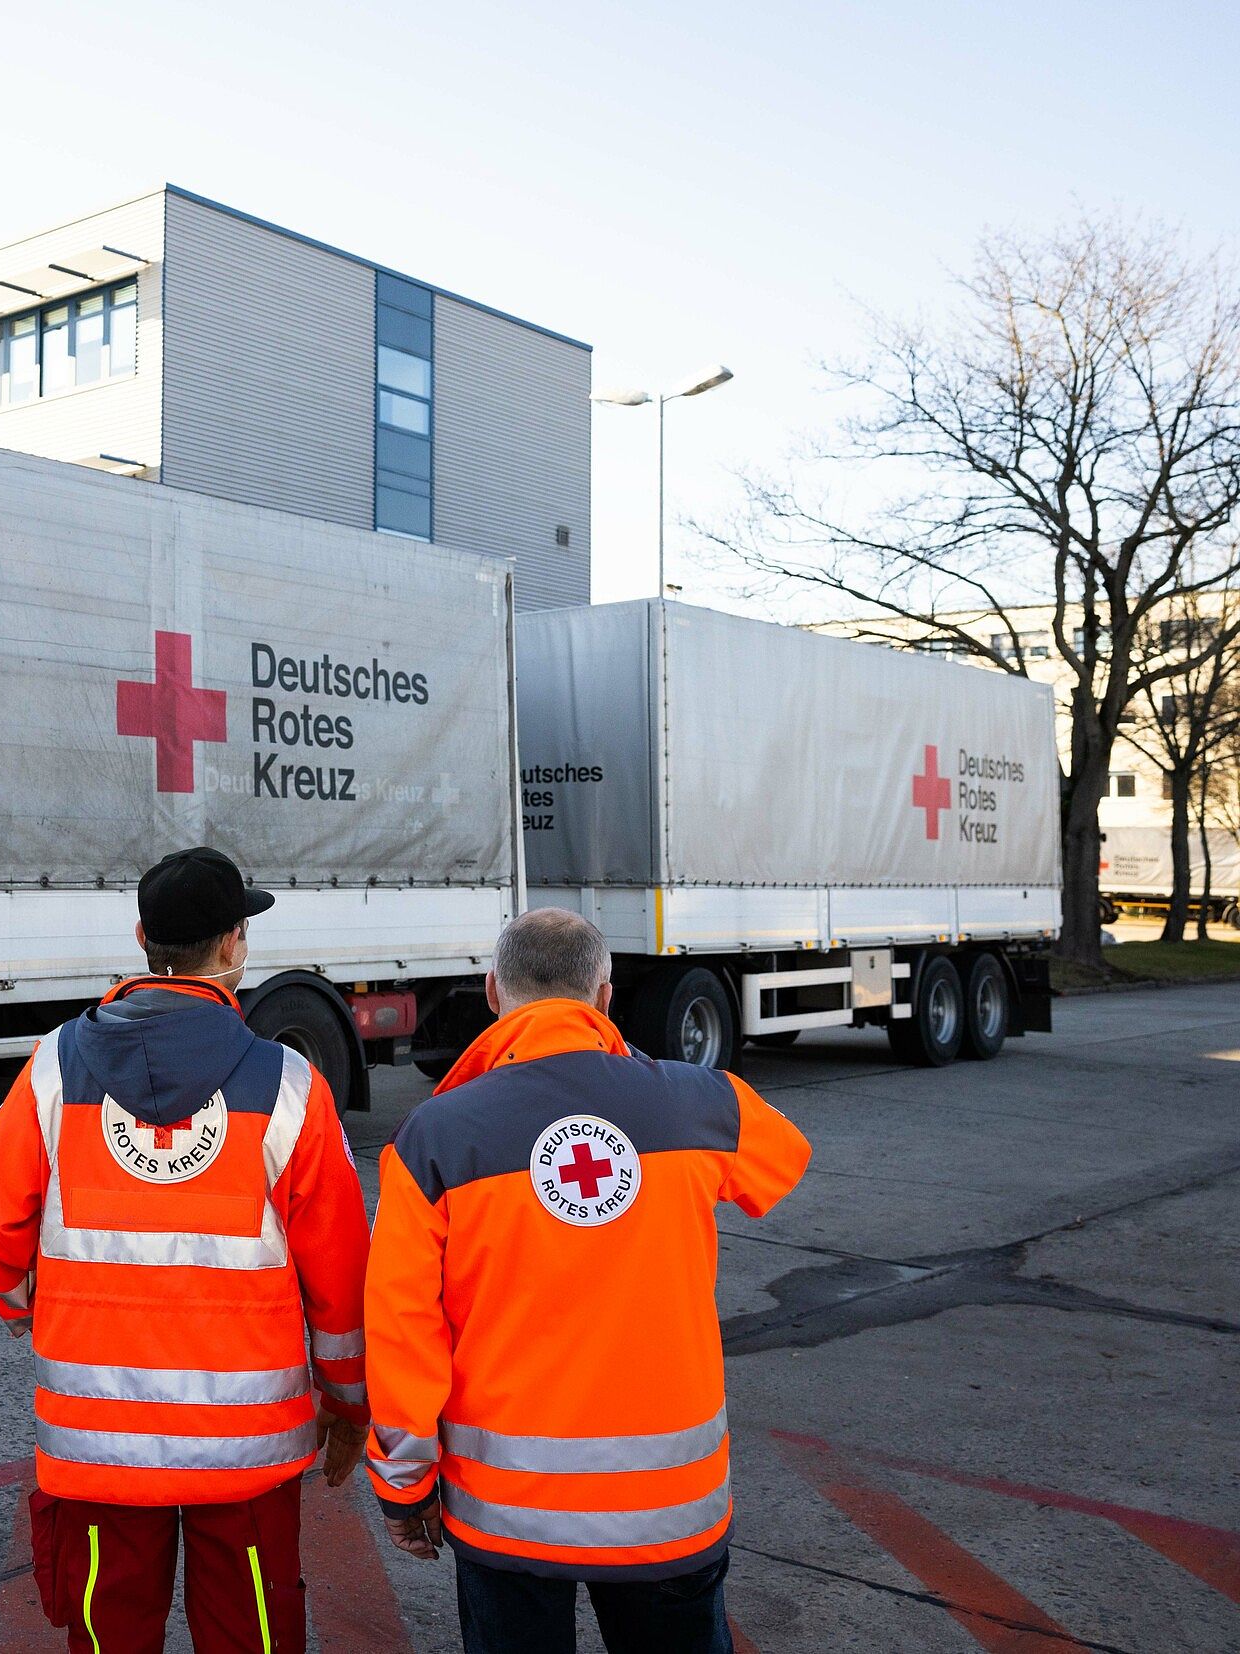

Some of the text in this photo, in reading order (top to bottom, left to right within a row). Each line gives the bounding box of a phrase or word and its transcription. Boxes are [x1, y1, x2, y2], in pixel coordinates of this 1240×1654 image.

[251, 642, 429, 705] Deutsches
[252, 697, 354, 749] Rotes
[254, 752, 356, 801] Kreuz
[520, 763, 603, 784] utsches
[959, 748, 1024, 782] Deutsches
[522, 788, 554, 807] tes
[959, 781, 996, 811] Rotes
[522, 815, 554, 831] euz
[959, 814, 998, 843] Kreuz
[112, 1121, 217, 1174] ROTES KREUZ
[539, 1123, 626, 1167] DEUTSCHES
[541, 1168, 633, 1218] ROTES KREUZ
